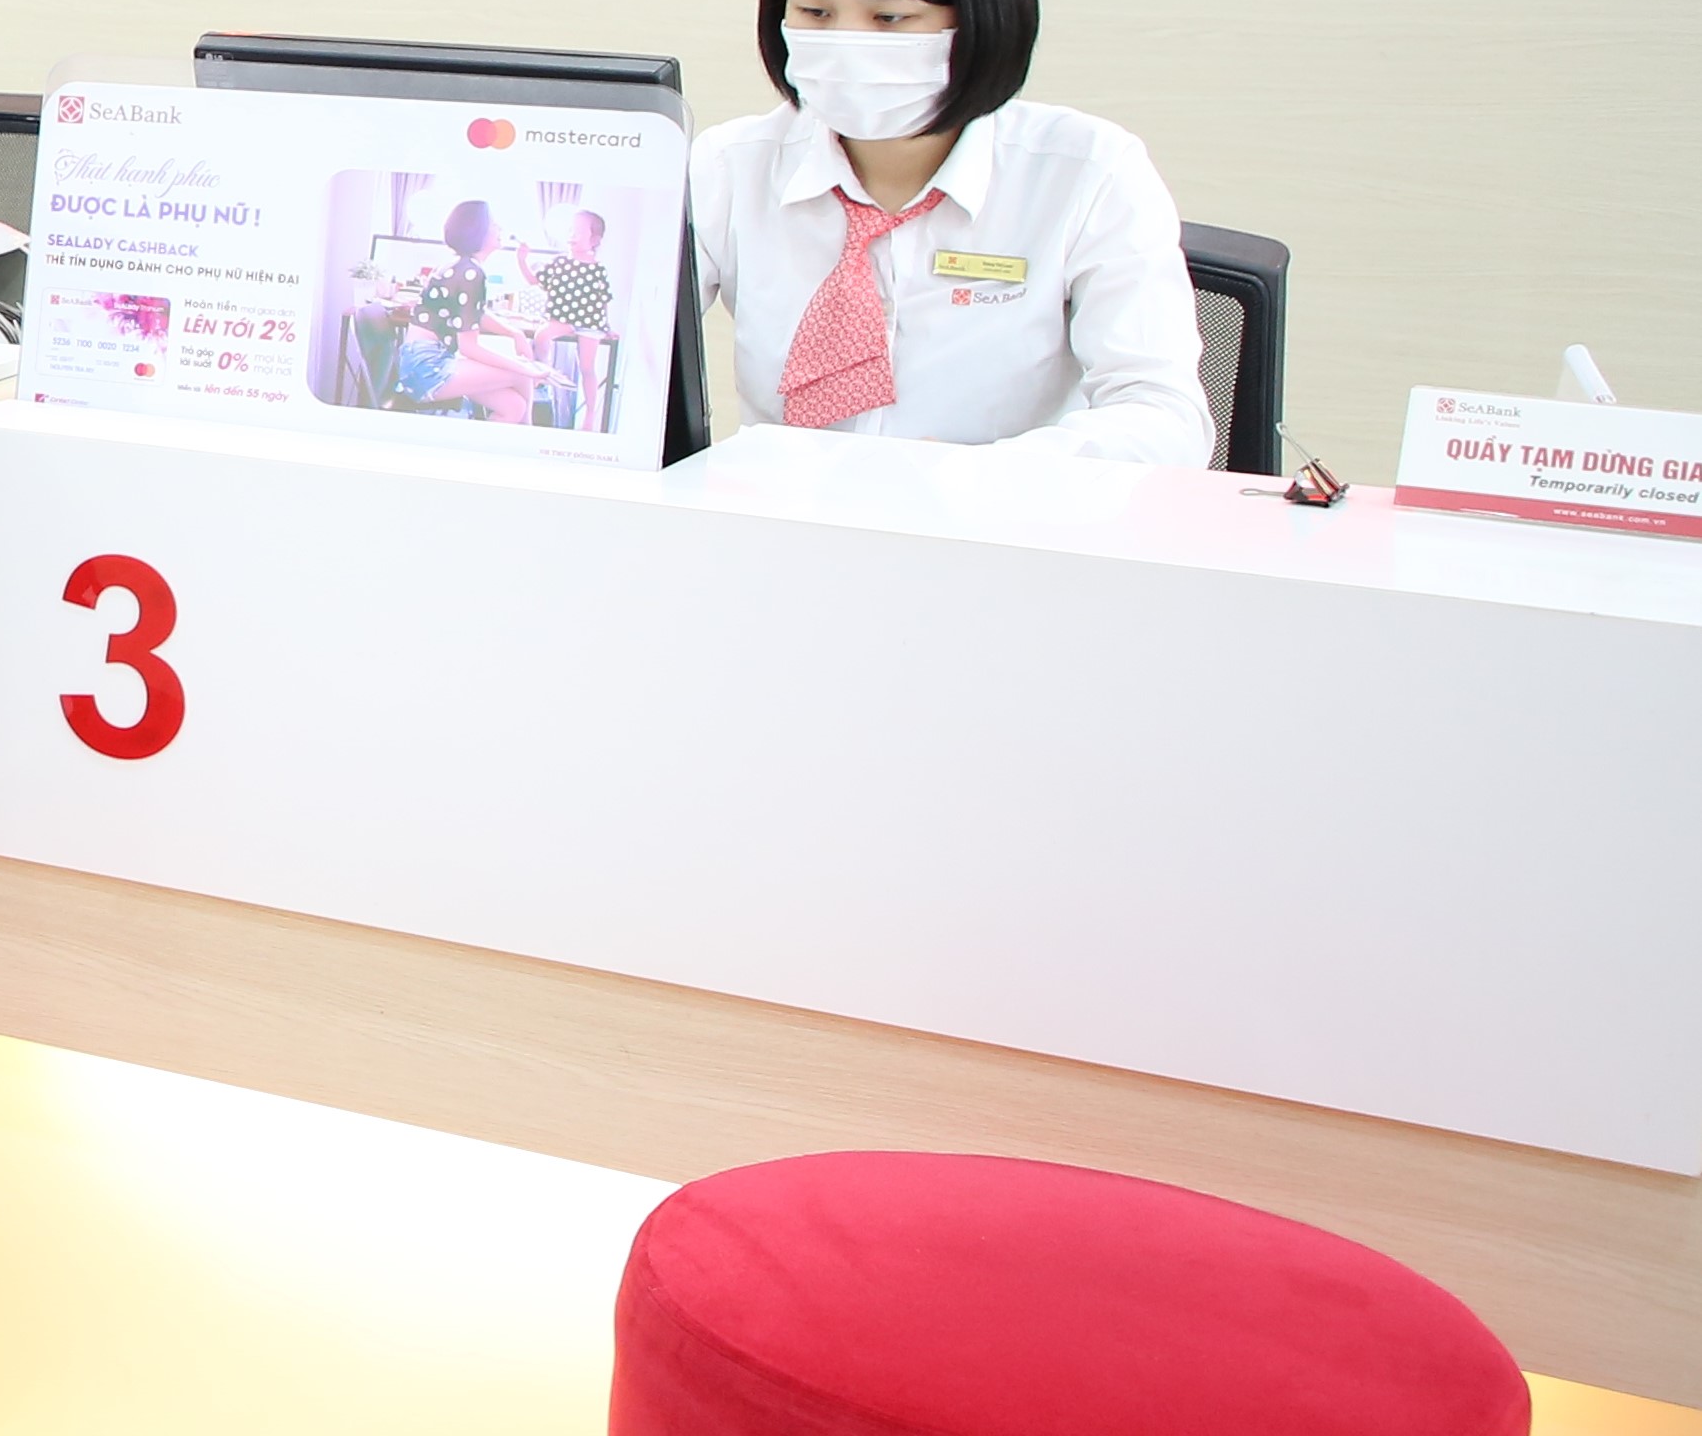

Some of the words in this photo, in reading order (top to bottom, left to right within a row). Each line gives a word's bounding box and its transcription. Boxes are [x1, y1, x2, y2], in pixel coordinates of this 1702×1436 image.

[89, 102, 182, 125] SeABank
[526, 130, 641, 148] mastercard
[50, 194, 117, 220] ĐƯỢC
[124, 194, 151, 219] LÀ
[159, 202, 207, 228] PHỤ
[214, 202, 249, 226] NỮ
[47, 234, 114, 251] SEALADY
[118, 240, 199, 257] CASHBACK
[45, 252, 65, 266] THẺ
[69, 255, 86, 267] TÍN
[90, 257, 124, 272] DỤNG
[128, 260, 161, 273] DÀNH
[166, 264, 193, 276] CHO
[197, 267, 222, 281] PHỤ
[225, 267, 242, 280] NỮ
[246, 269, 273, 285] HIỆN
[278, 273, 299, 288] ĐẠI
[185, 299, 213, 309] Hoàn
[217, 300, 237, 311] tiền
[183, 314, 217, 335] LÊN
[223, 317, 255, 338] TỚI
[259, 319, 295, 342] 2%
[218, 351, 249, 372] 0%
[1458, 403, 1521, 417] SeABank
[1446, 435, 1513, 463] QUẦY
[1521, 446, 1575, 472] TẠM
[1582, 448, 1654, 478] DỪNG
[1530, 475, 1633, 499] Temporarily
[1638, 487, 1699, 504] closed
[1553, 508, 1666, 526] www.seabank.com.vn
[59, 554, 185, 760] 3
